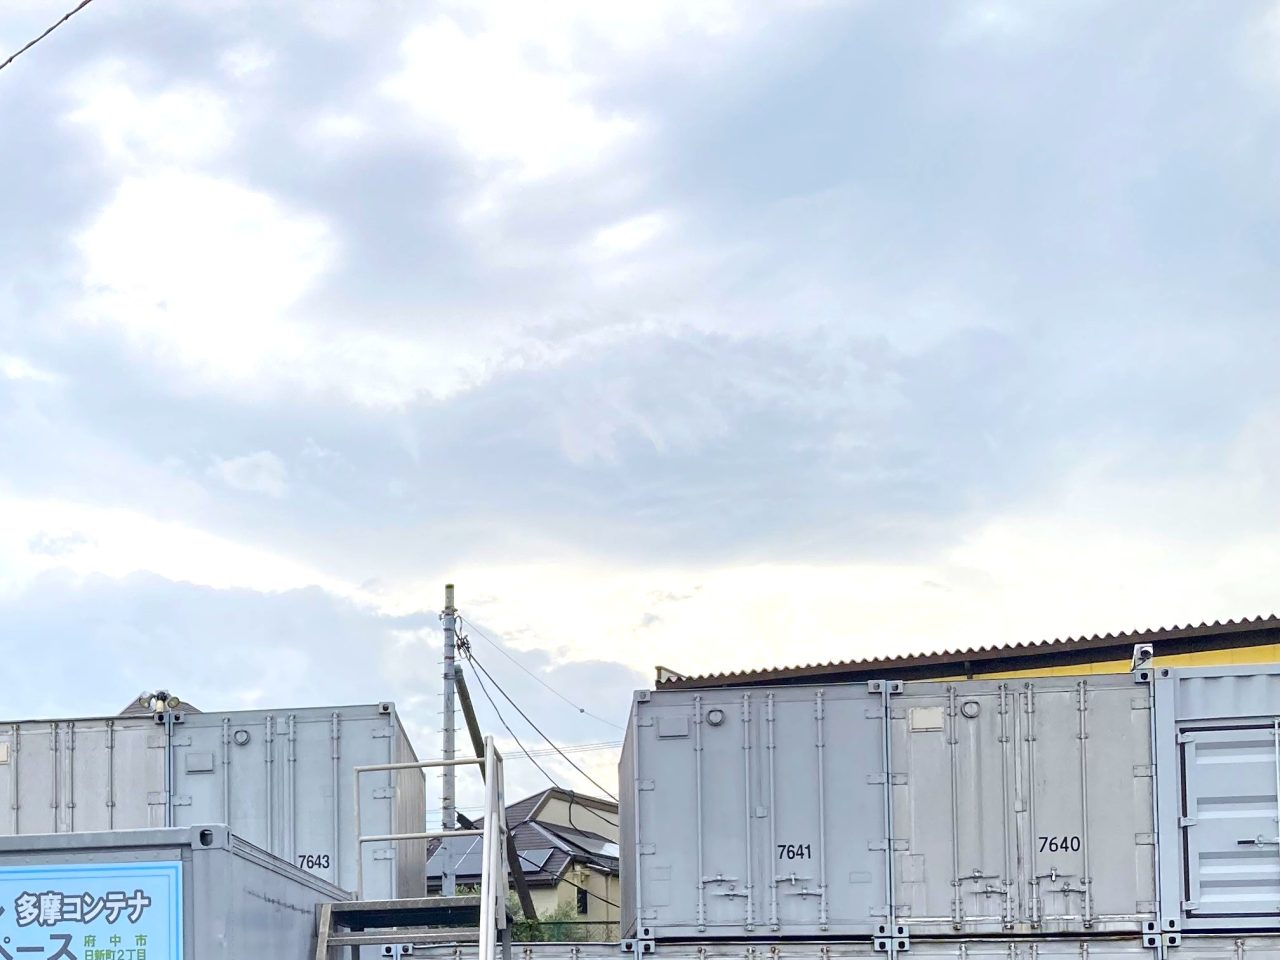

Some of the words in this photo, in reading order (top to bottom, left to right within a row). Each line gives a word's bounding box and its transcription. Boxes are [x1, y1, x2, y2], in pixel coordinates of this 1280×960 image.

[777, 844, 811, 860] 7641
[1038, 836, 1081, 853] 7640
[297, 854, 330, 870] 7643
[15, 889, 151, 927] 多摩コンテナ
